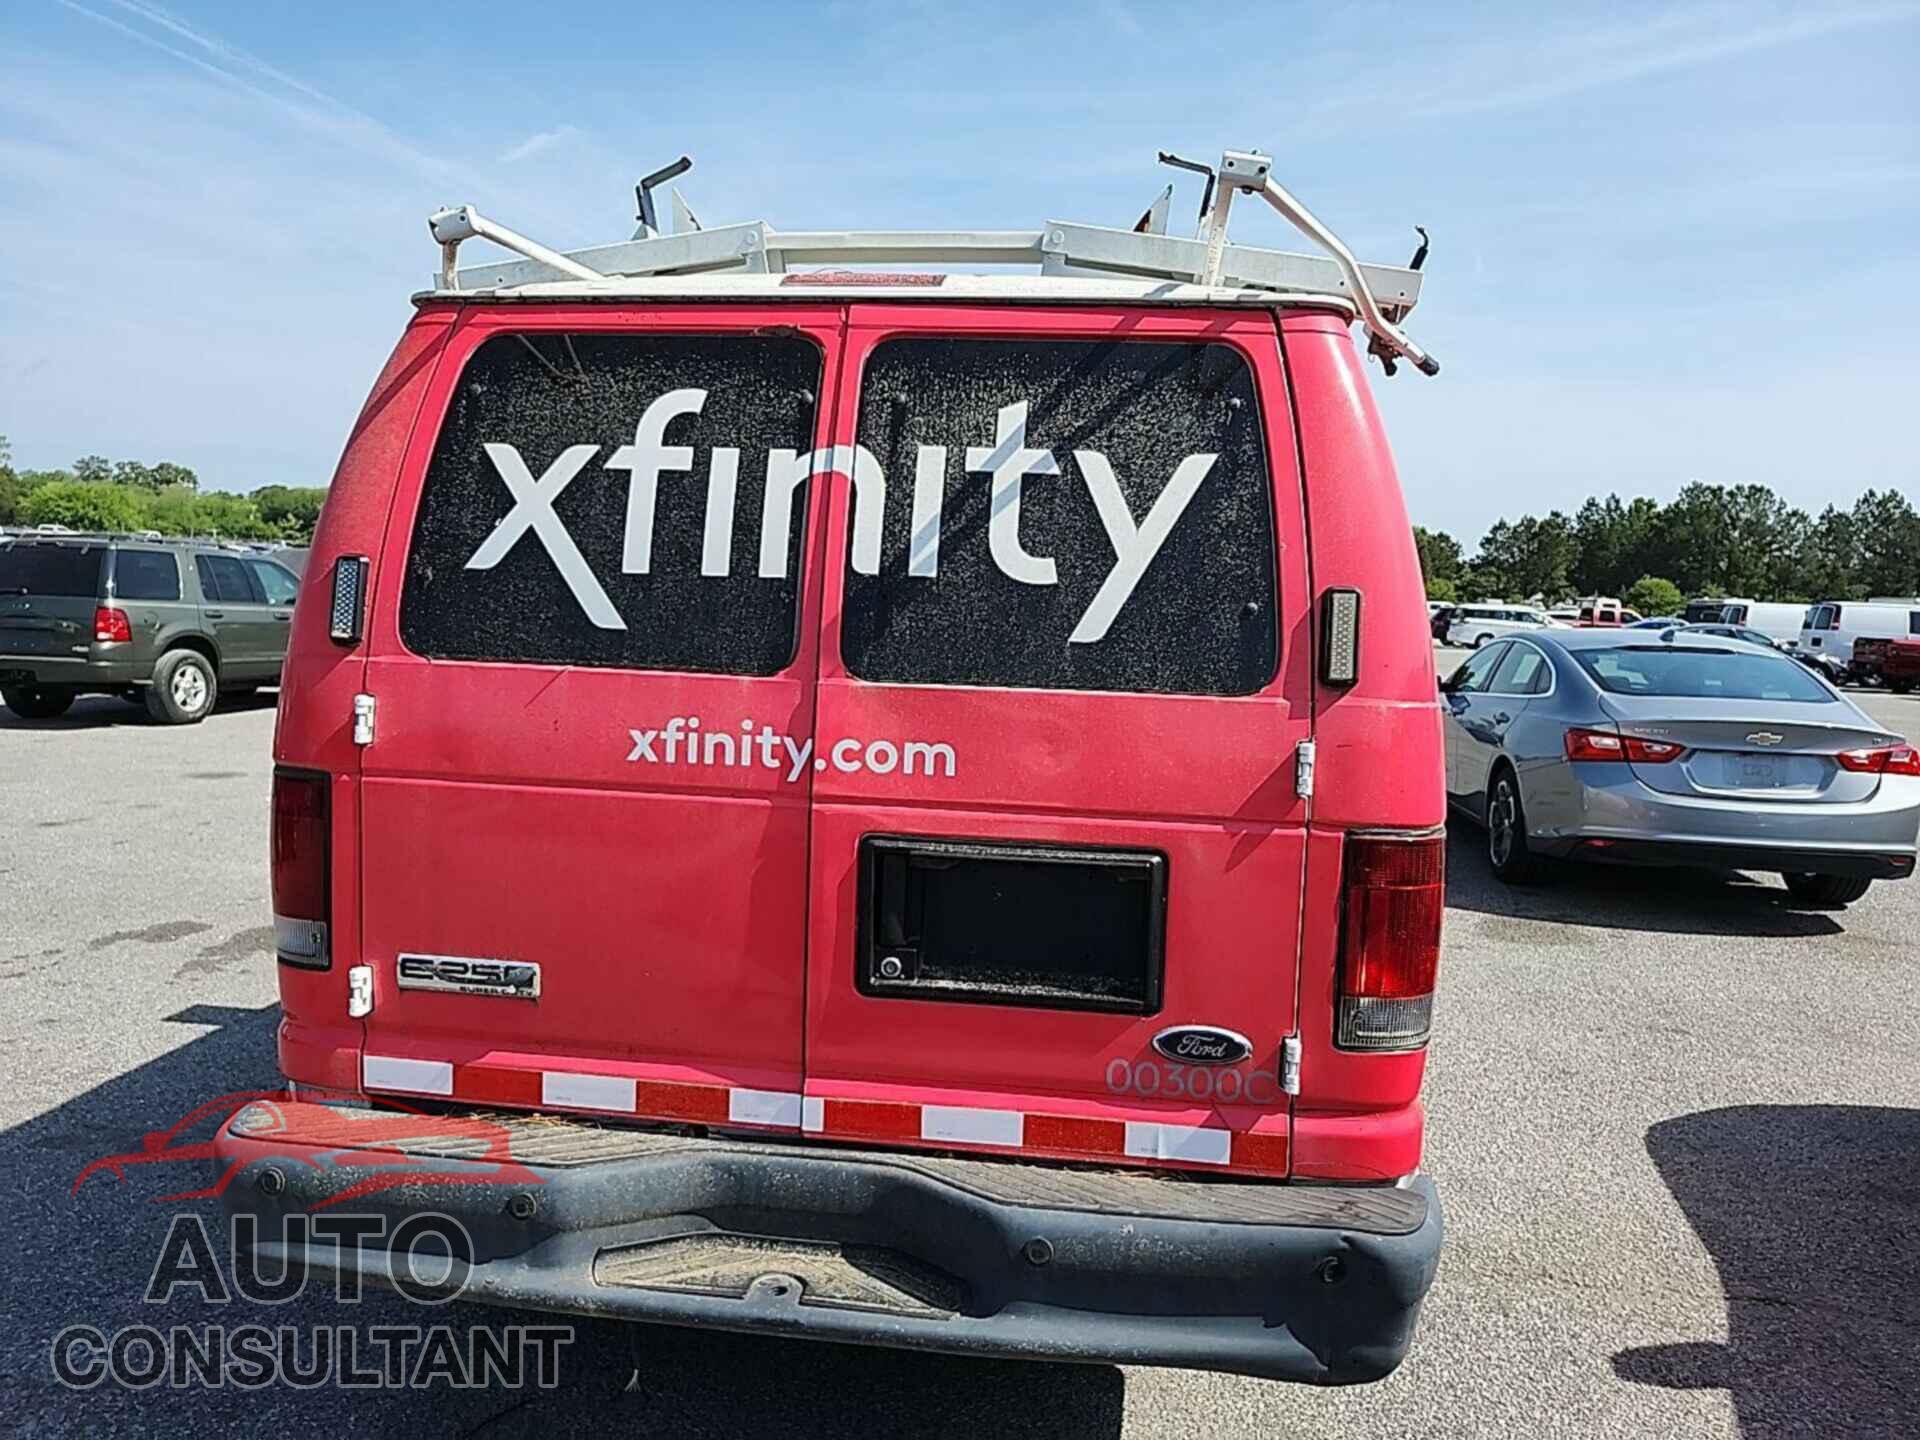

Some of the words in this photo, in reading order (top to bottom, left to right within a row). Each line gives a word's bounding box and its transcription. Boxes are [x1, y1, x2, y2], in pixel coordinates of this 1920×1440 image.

[464, 387, 1219, 644] xfinity
[627, 719, 956, 782] xfinity.com
[1177, 1034, 1227, 1058] Ford
